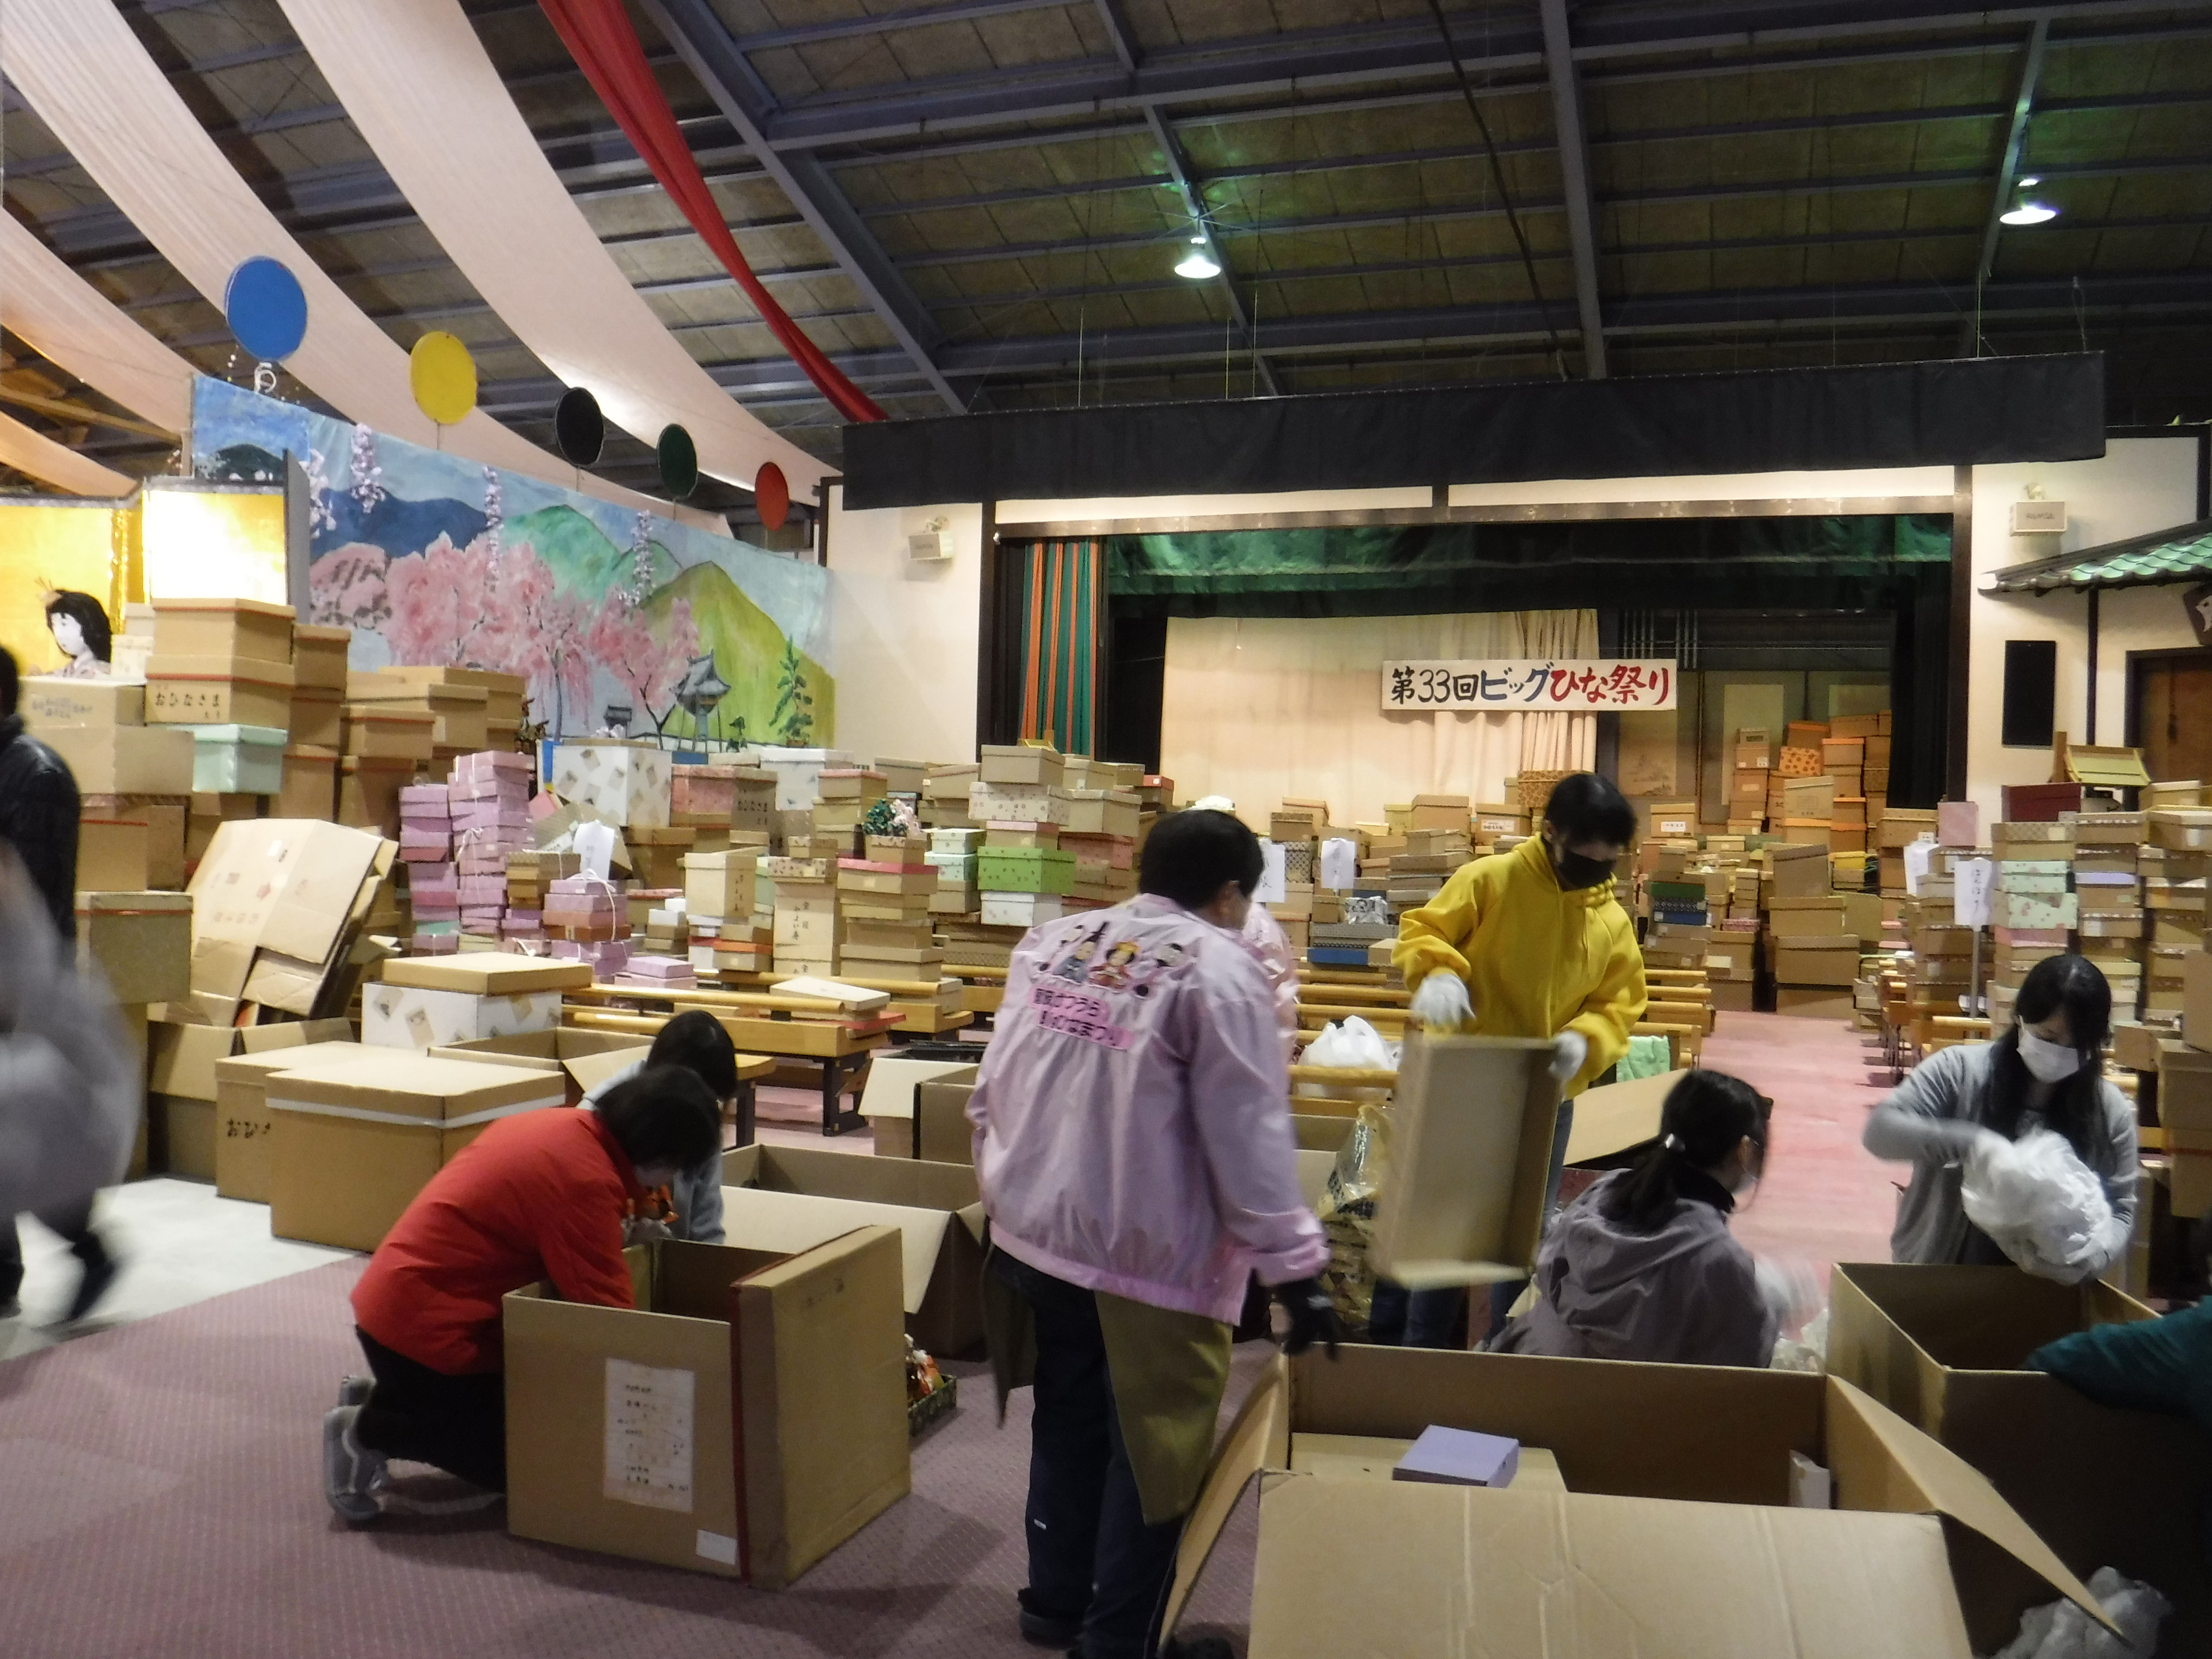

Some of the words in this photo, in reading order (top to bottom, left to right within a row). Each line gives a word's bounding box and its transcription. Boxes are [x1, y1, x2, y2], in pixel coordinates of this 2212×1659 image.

[1392, 661, 1669, 705] 第33回ビッグひな祭り
